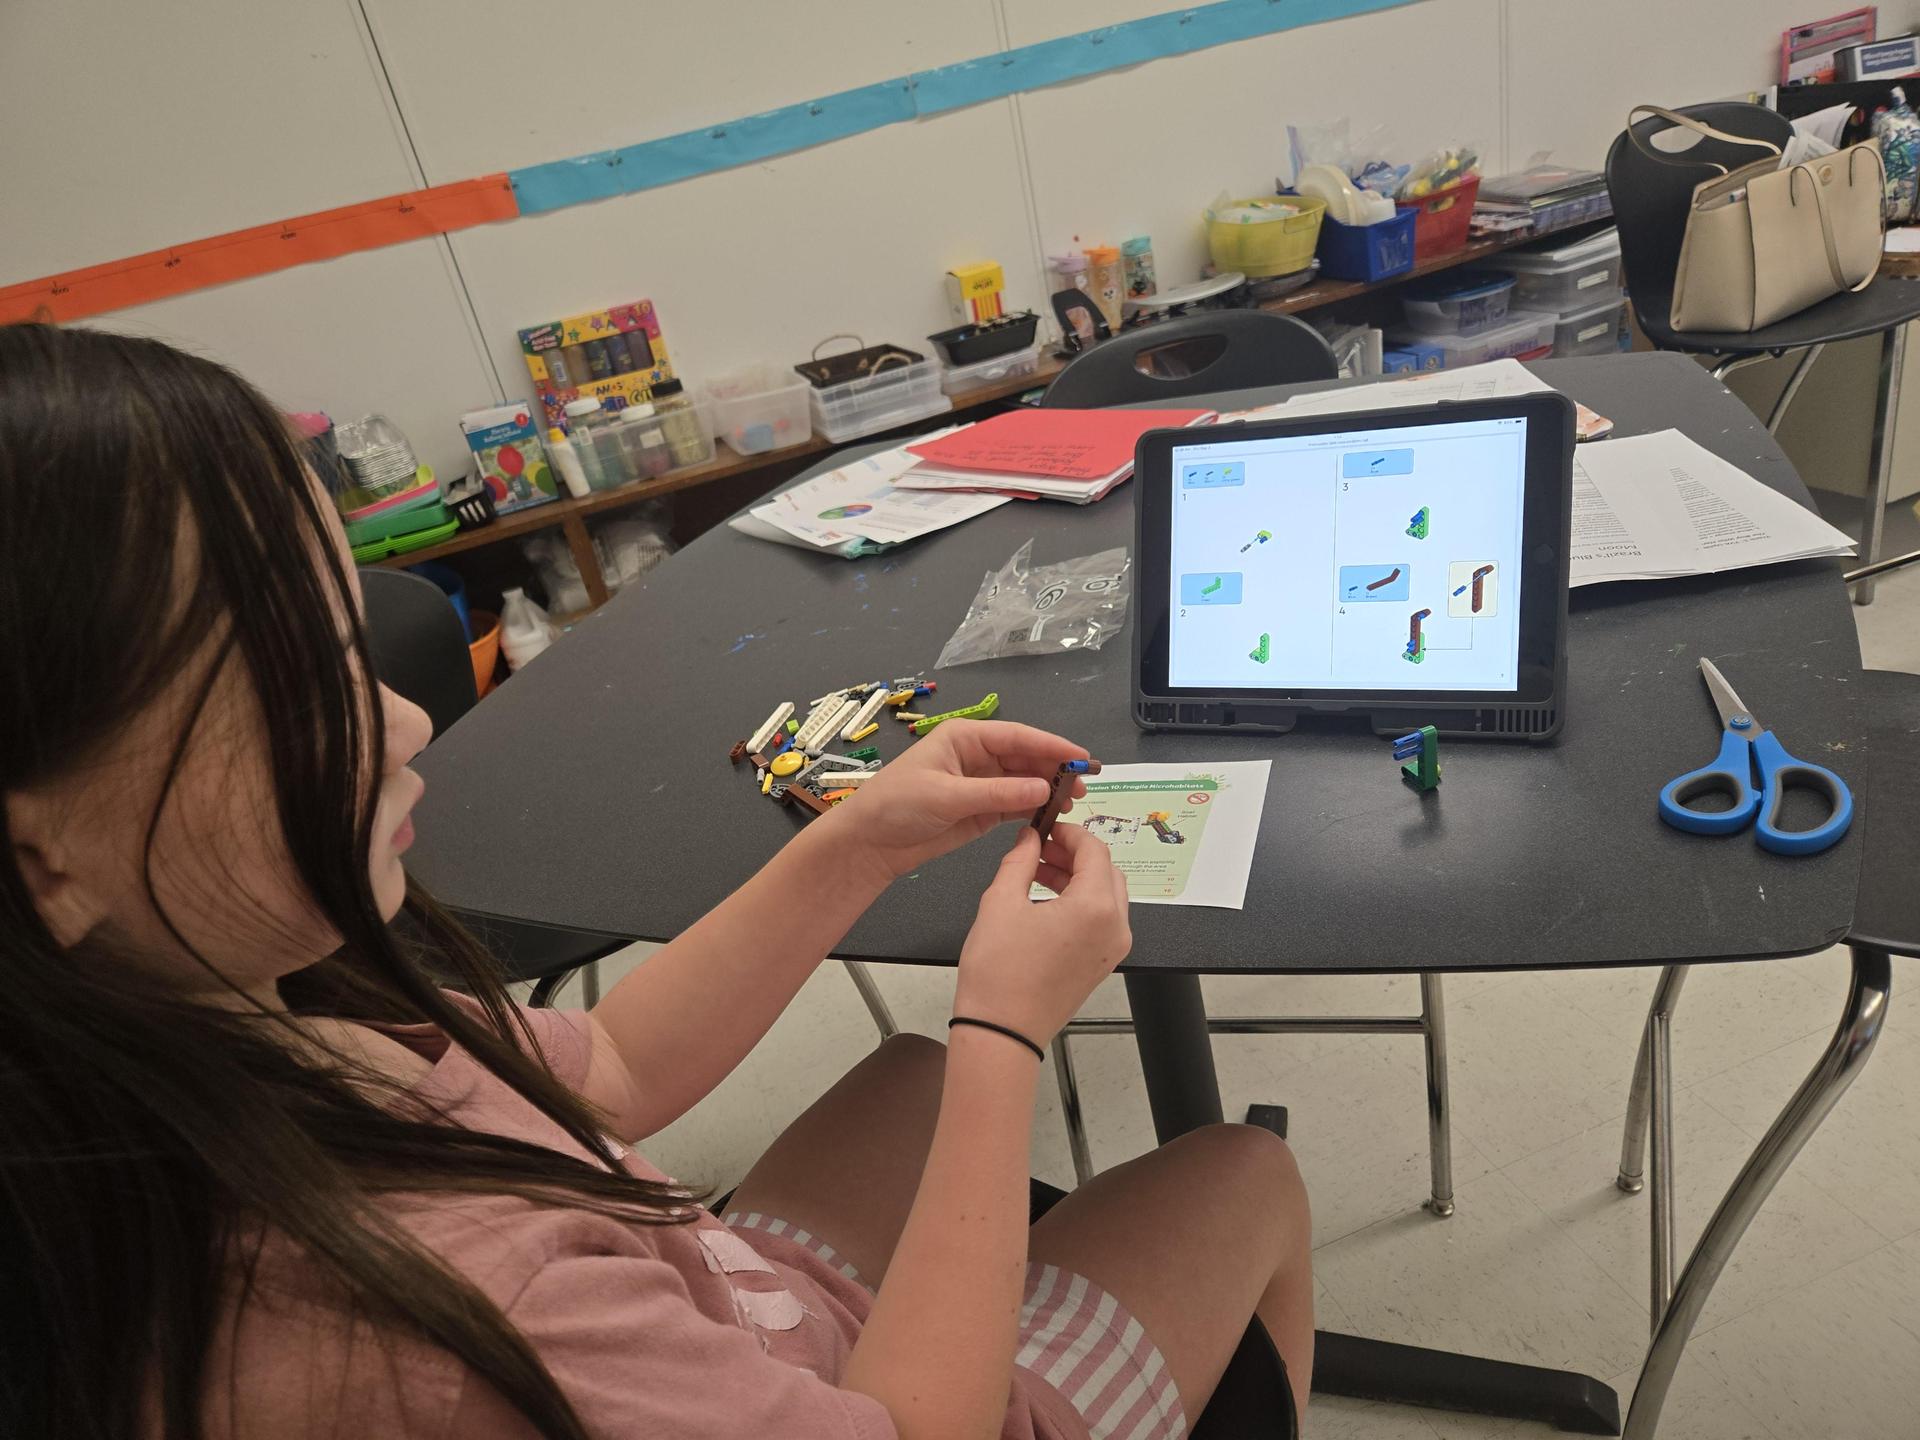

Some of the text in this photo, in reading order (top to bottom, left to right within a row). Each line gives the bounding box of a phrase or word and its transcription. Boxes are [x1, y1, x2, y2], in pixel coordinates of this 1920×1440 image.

[1342, 482, 1349, 492] 3
[1182, 493, 1187, 501] 1
[1597, 544, 1638, 552] Moon
[1180, 608, 1187, 617] 2
[1339, 606, 1346, 616] 4
